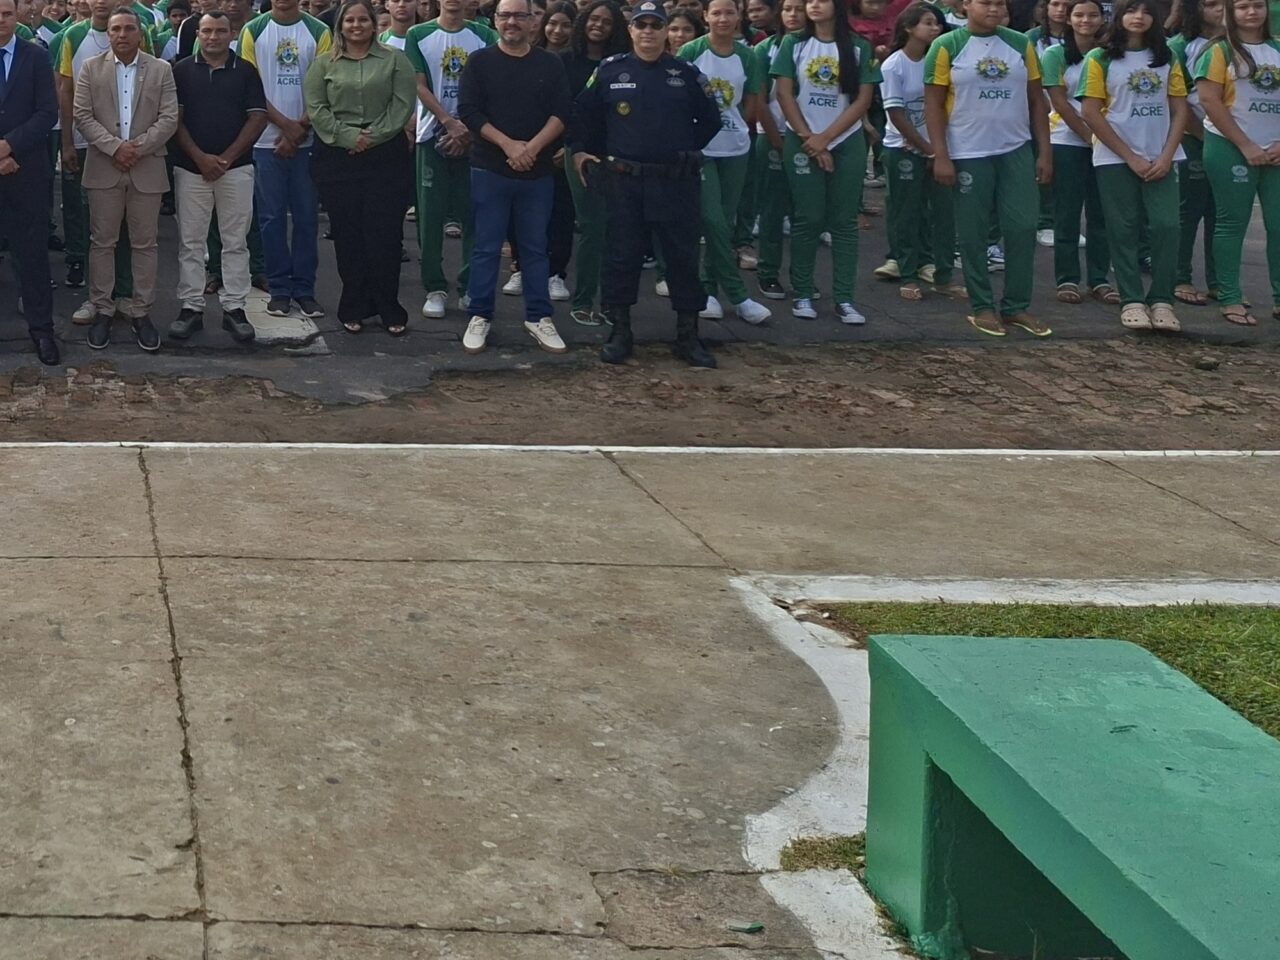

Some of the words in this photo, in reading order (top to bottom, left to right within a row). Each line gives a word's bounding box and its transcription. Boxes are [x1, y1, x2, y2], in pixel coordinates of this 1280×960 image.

[277, 77, 301, 86] ACRE
[979, 90, 1011, 100] ACRE
[808, 97, 838, 108] ACRE
[1248, 102, 1280, 114] ACRE
[1130, 106, 1164, 118] ACRE
